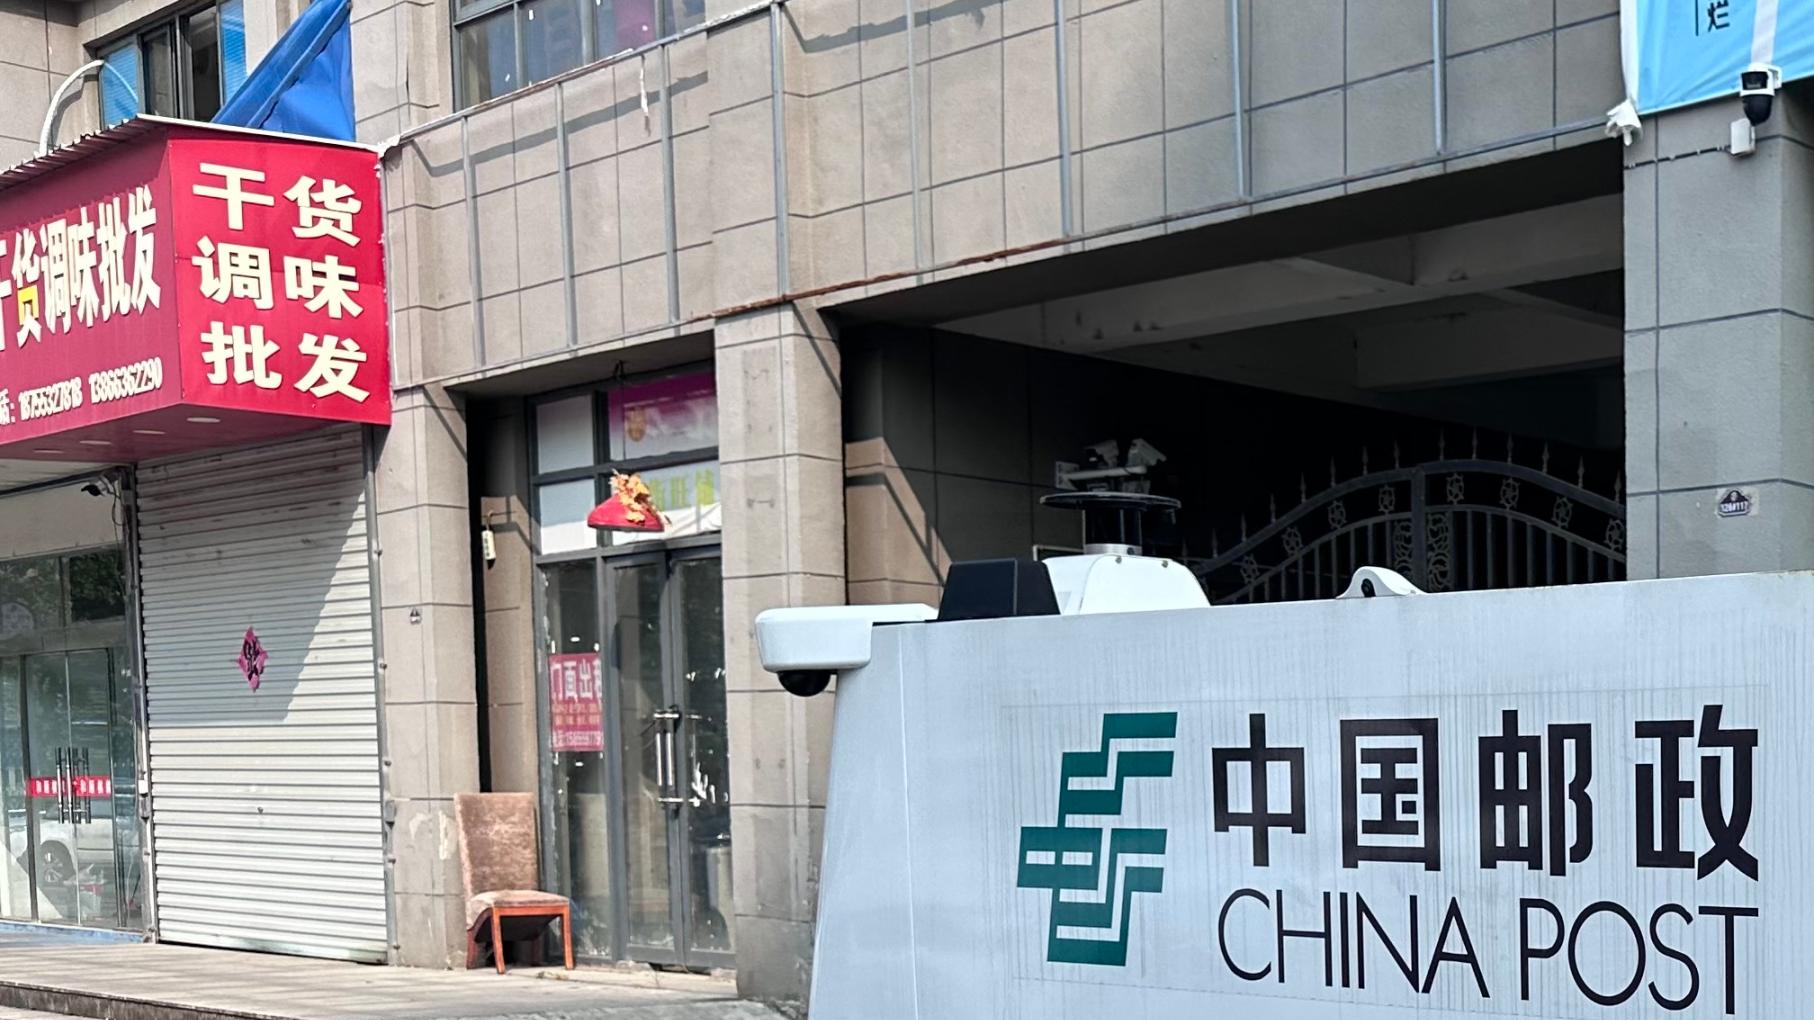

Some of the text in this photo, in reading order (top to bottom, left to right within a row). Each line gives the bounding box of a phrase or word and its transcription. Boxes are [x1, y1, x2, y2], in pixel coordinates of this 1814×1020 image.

[192, 162, 363, 248] 干货
[190, 236, 364, 321] 调味
[200, 321, 370, 404] 批发
[1210, 703, 1760, 882] 中国邮政
[1217, 887, 1760, 1015] CHINA POST
